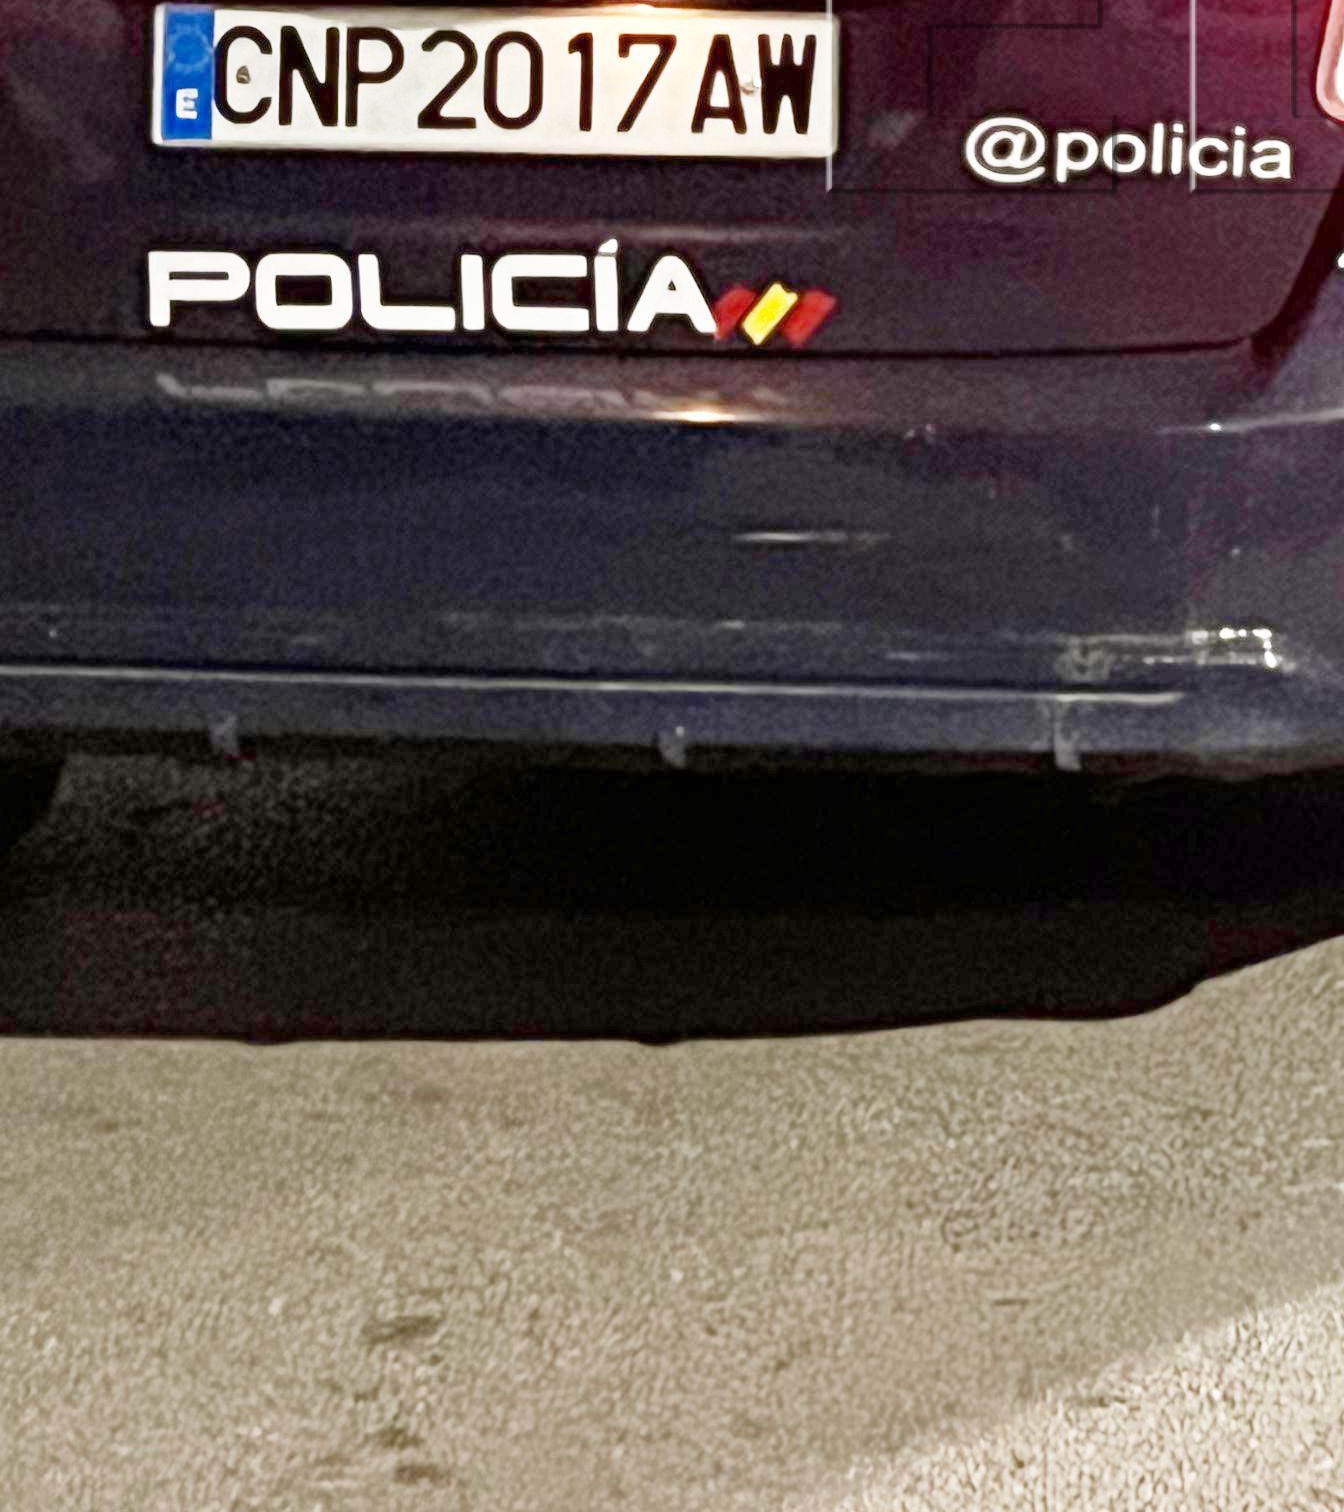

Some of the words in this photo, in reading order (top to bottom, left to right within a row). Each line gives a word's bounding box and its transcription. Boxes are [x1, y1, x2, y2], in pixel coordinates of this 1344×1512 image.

[176, 88, 199, 120] E
[965, 117, 1292, 183] @policia
[148, 238, 719, 334] POLICÍA
